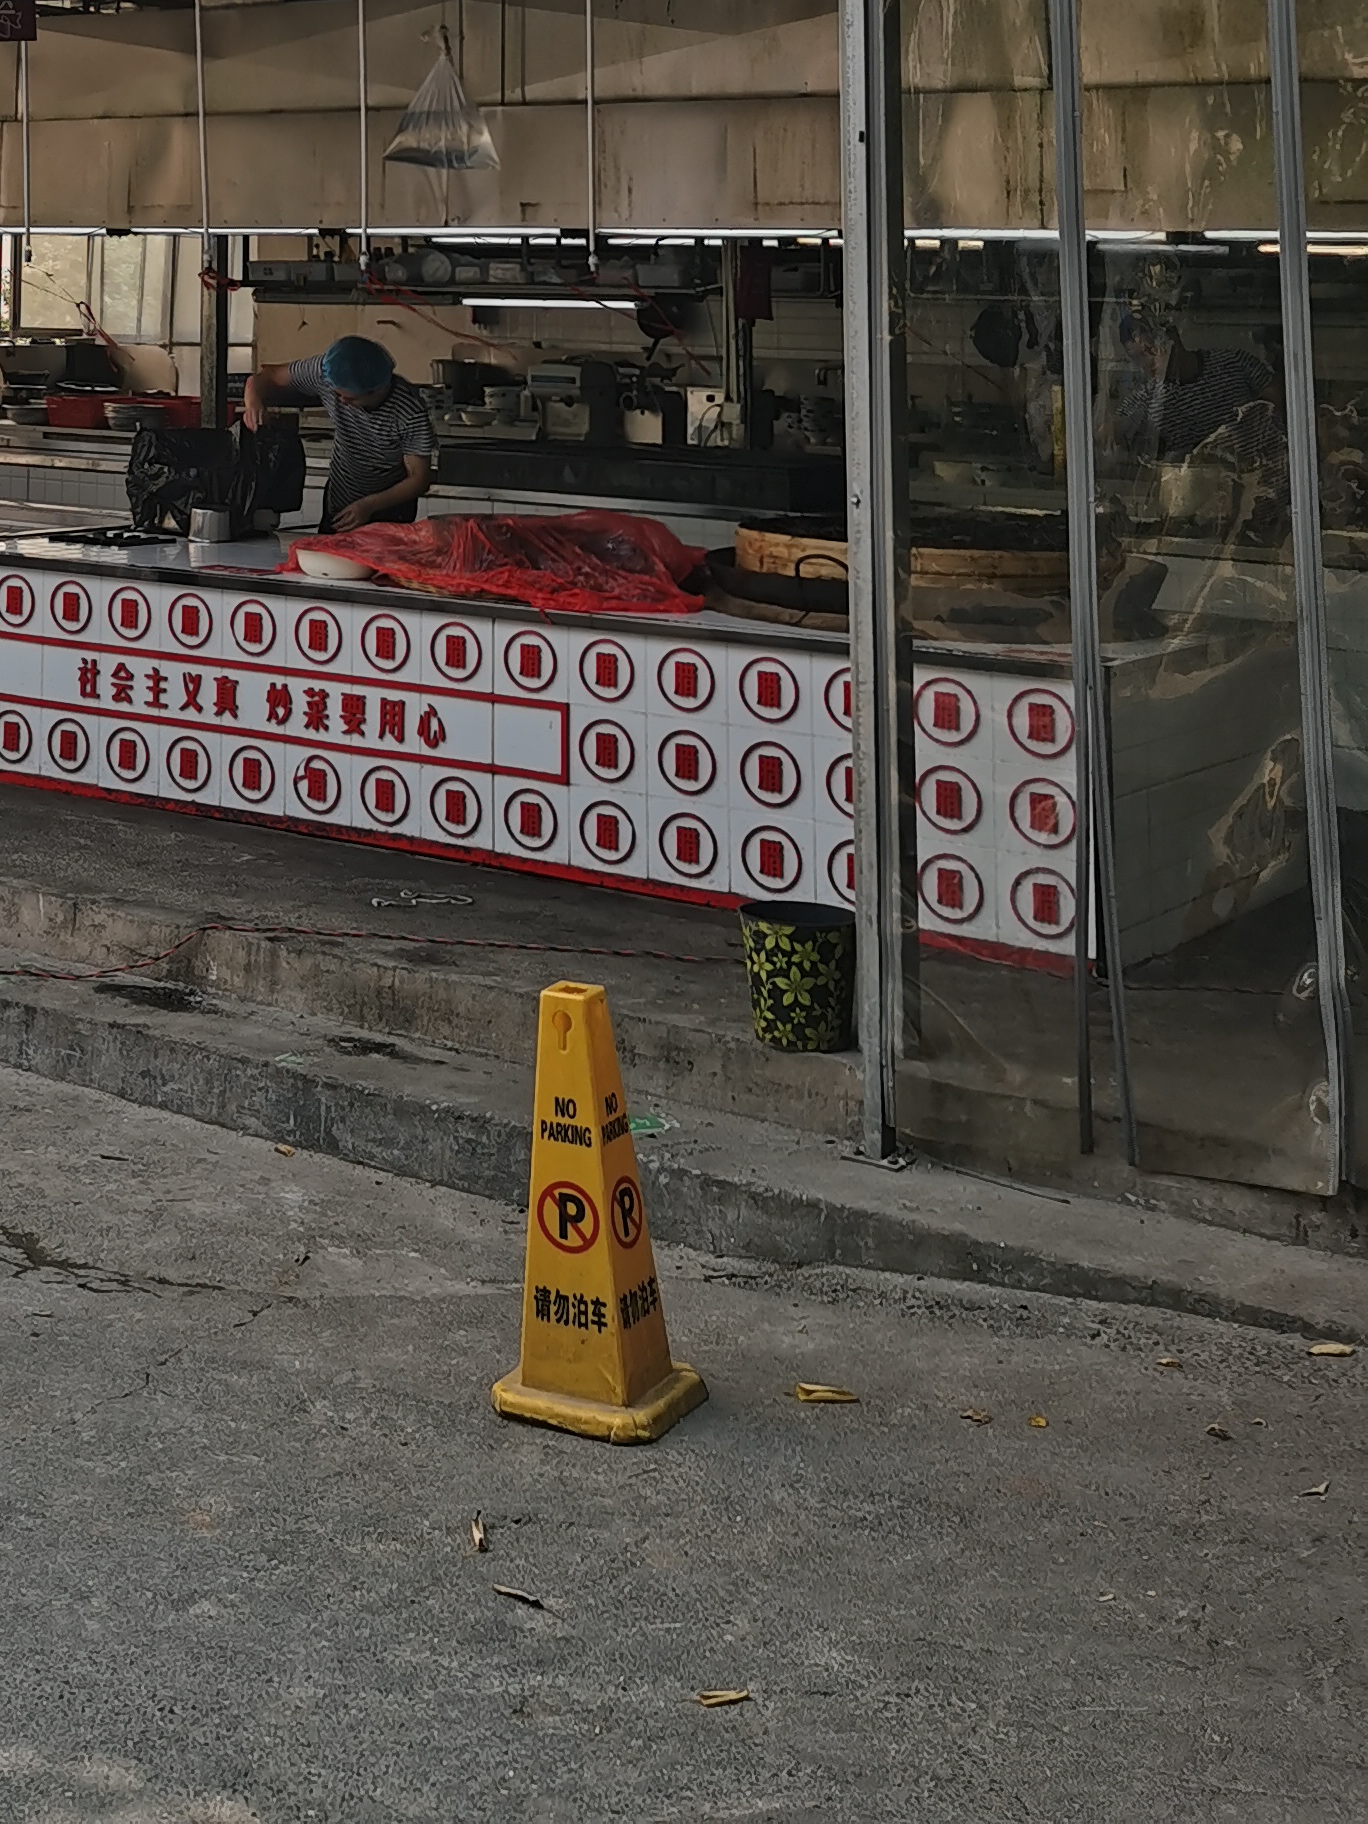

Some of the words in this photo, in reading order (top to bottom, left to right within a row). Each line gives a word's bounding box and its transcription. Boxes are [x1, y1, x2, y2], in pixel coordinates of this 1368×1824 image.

[77, 656, 240, 719] 社会主义真
[265, 682, 447, 750] 炒菜要用心
[554, 1095, 577, 1120] NO
[604, 1091, 619, 1118] NO
[540, 1118, 593, 1149] PARKING
[533, 1284, 608, 1335] 请勿泊车
[619, 1275, 659, 1330] 请勿泊车
